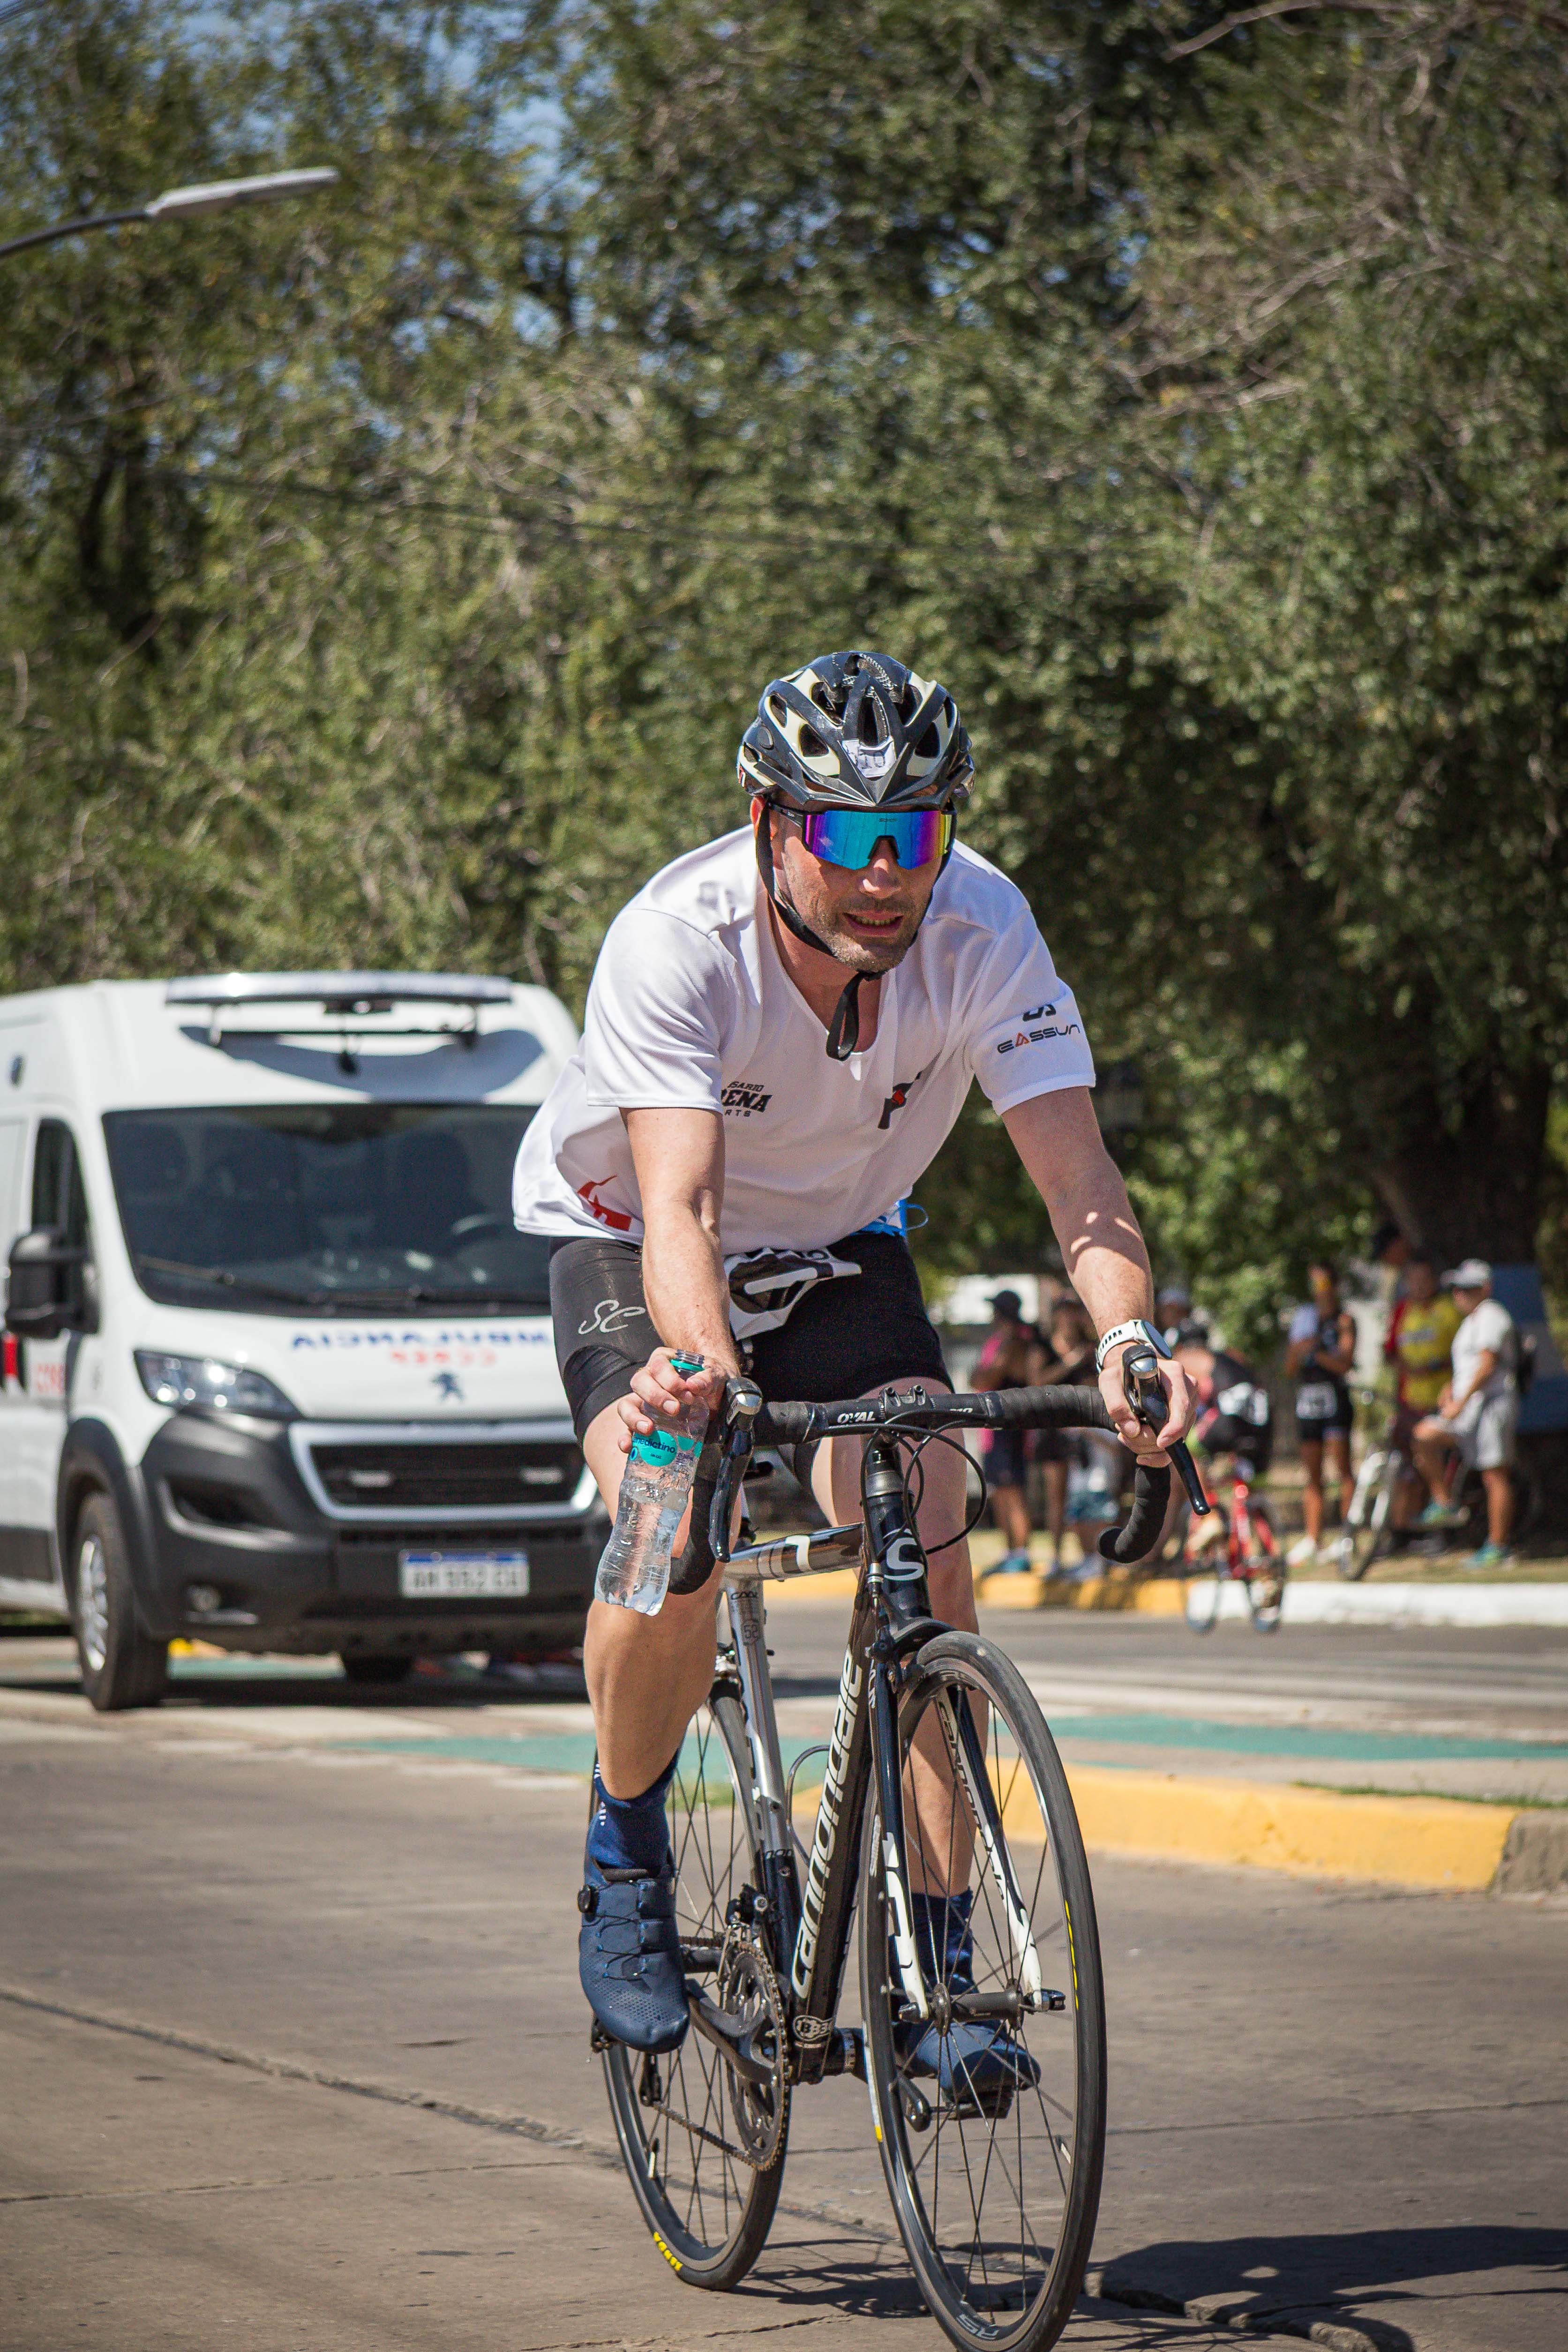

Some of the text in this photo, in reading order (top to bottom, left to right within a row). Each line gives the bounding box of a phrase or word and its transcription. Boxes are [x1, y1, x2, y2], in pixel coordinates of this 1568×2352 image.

[837, 1411, 876, 1424] OVAL
[632, 1436, 676, 1453] enedictino
[791, 1644, 863, 1999] cannondale
